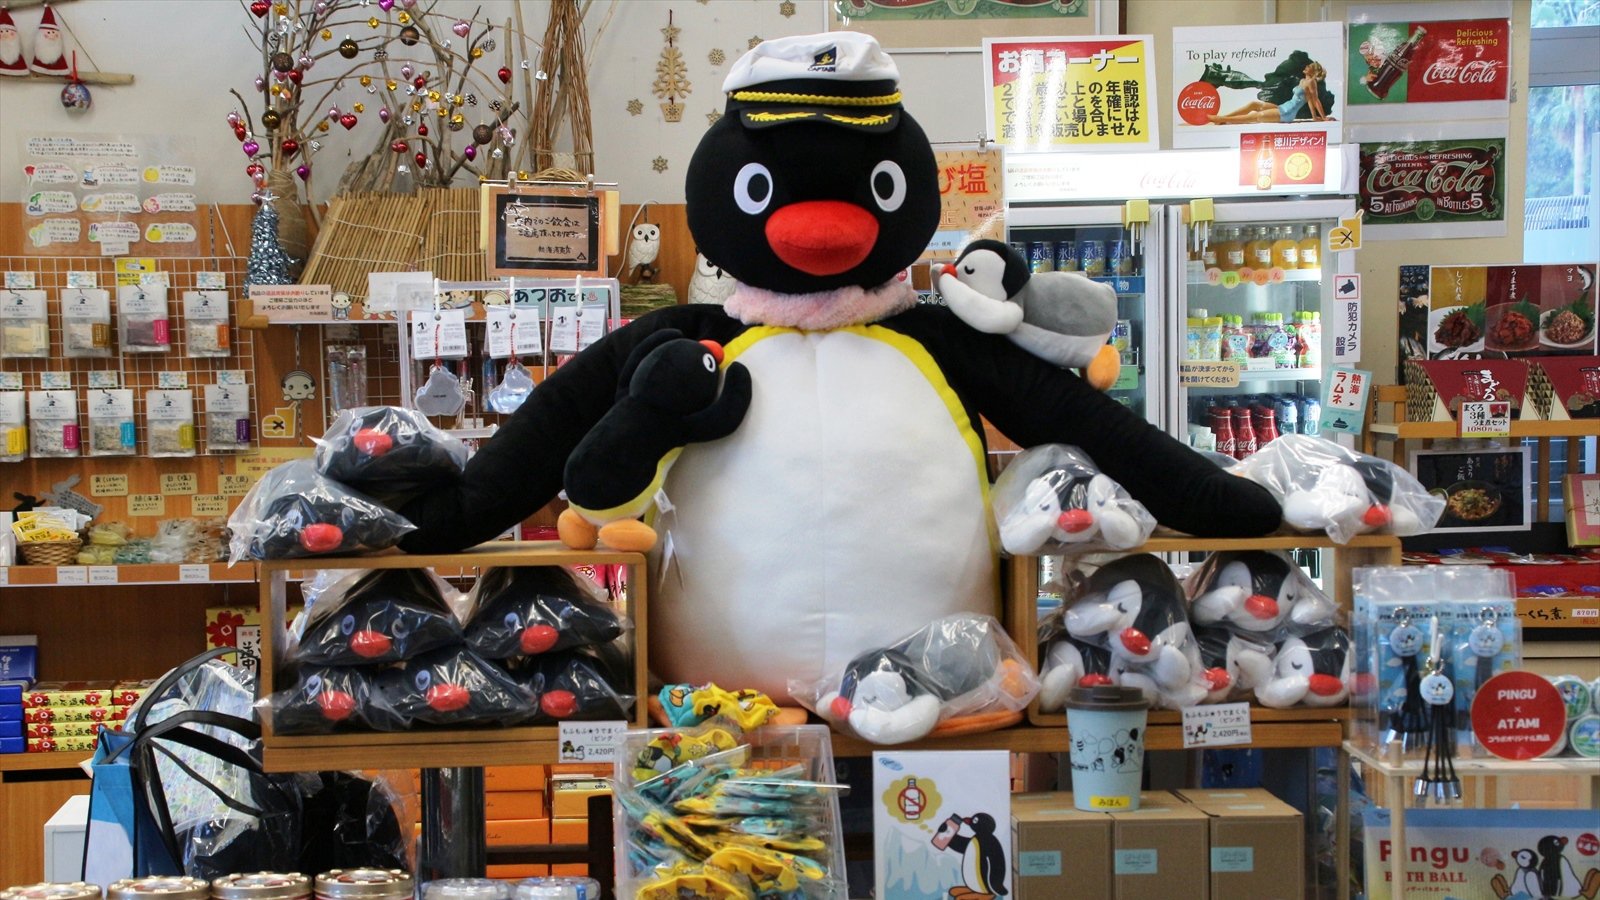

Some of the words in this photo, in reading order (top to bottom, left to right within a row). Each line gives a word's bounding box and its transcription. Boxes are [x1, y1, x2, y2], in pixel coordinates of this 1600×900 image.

[1456, 29, 1493, 37] Delicious
[1456, 37, 1498, 47] Refreshing
[1187, 50, 1200, 61] To
[1203, 49, 1227, 63] play
[1231, 47, 1277, 62] refreshed
[1423, 60, 1499, 85] Coca-Cola
[1002, 80, 1139, 96] 2歳以上の年齢
[1181, 95, 1216, 110] Coca-Cola
[1429, 152, 1473, 161] REFRESHING
[1366, 160, 1489, 196] Coca-Cola
[1442, 196, 1470, 210] BOTTLES
[1347, 302, 1358, 352] 防犯カメラ
[1335, 336, 1346, 356] 設置
[1332, 371, 1347, 405] ラムネ
[1350, 373, 1361, 395] 熱海
[1480, 369, 1500, 401] まぐろ
[1464, 403, 1484, 412] まぐろ
[1497, 689, 1538, 701] PINGU
[1497, 718, 1540, 730] ATAMI
[1212, 729, 1239, 739] 2,420円
[588, 747, 616, 757] 2,420円
[1098, 798, 1122, 807] みほん
[1379, 840, 1470, 870] Pngu
[1384, 871, 1424, 883] BTH
[1429, 871, 1468, 883] BALL
